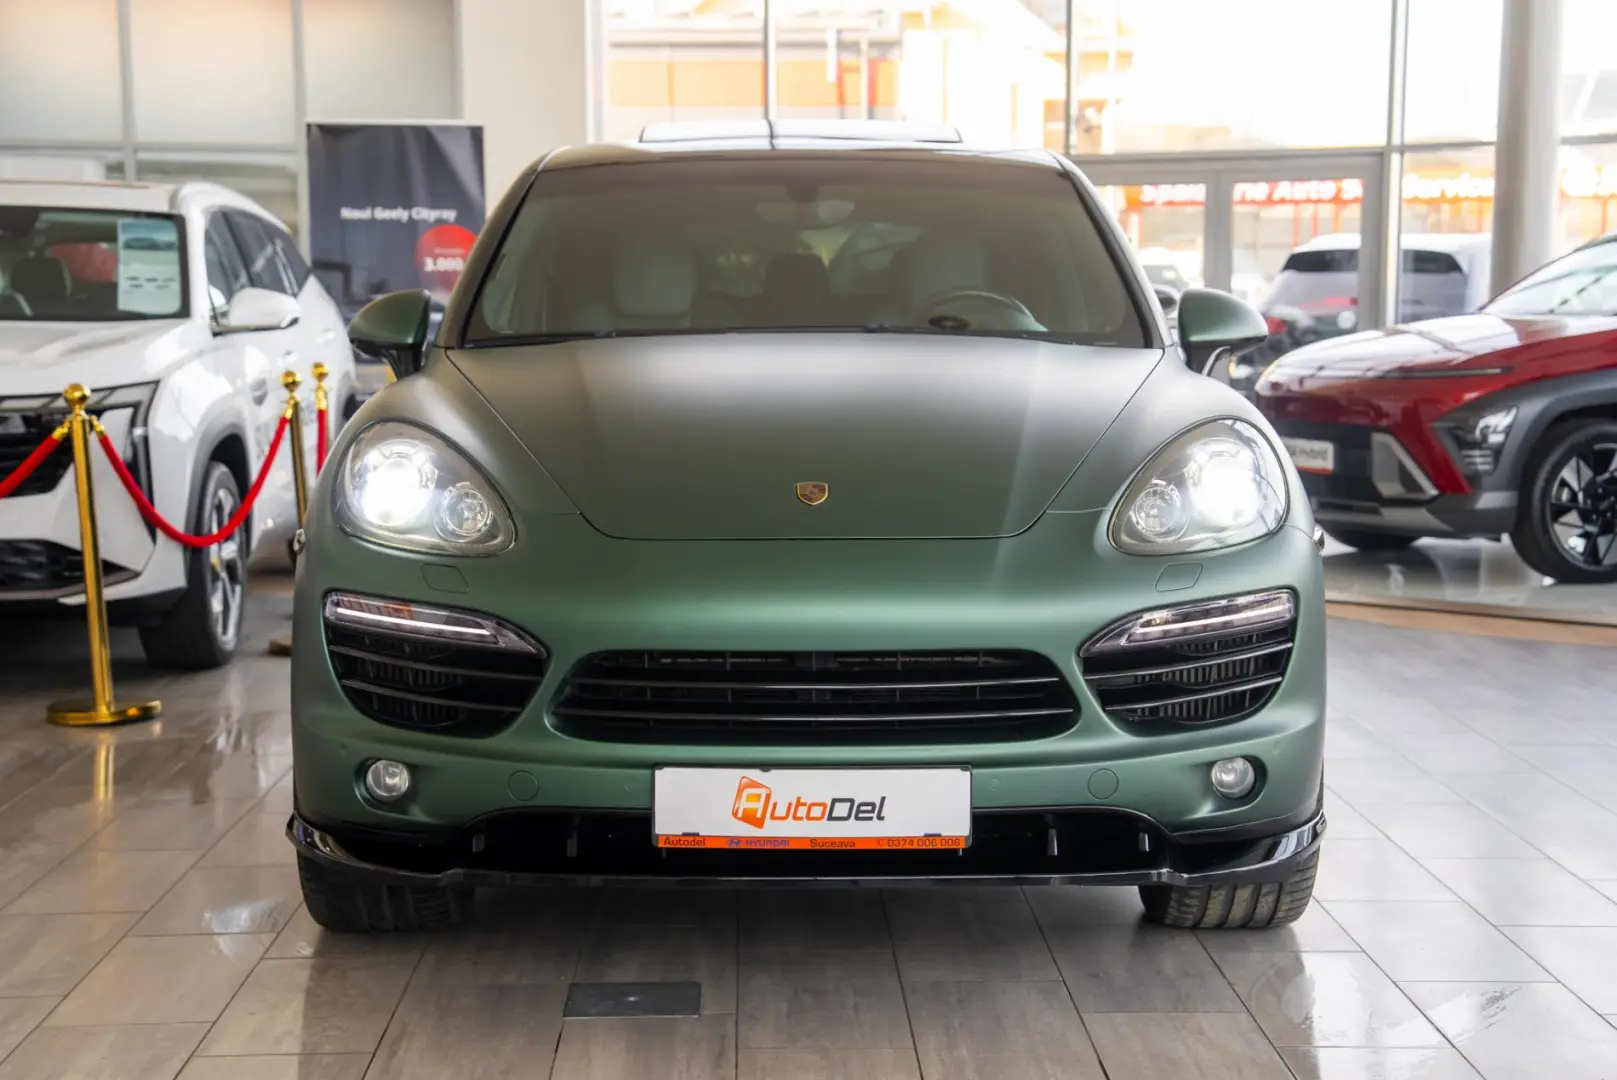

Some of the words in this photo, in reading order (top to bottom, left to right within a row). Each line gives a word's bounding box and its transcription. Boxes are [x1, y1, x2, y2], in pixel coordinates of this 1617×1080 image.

[732, 776, 886, 829] AutoDel
[663, 836, 706, 847] Autodel
[810, 839, 856, 848] Suceava
[887, 838, 914, 847] 0374
[917, 838, 937, 847] 006
[940, 838, 961, 847] 006
